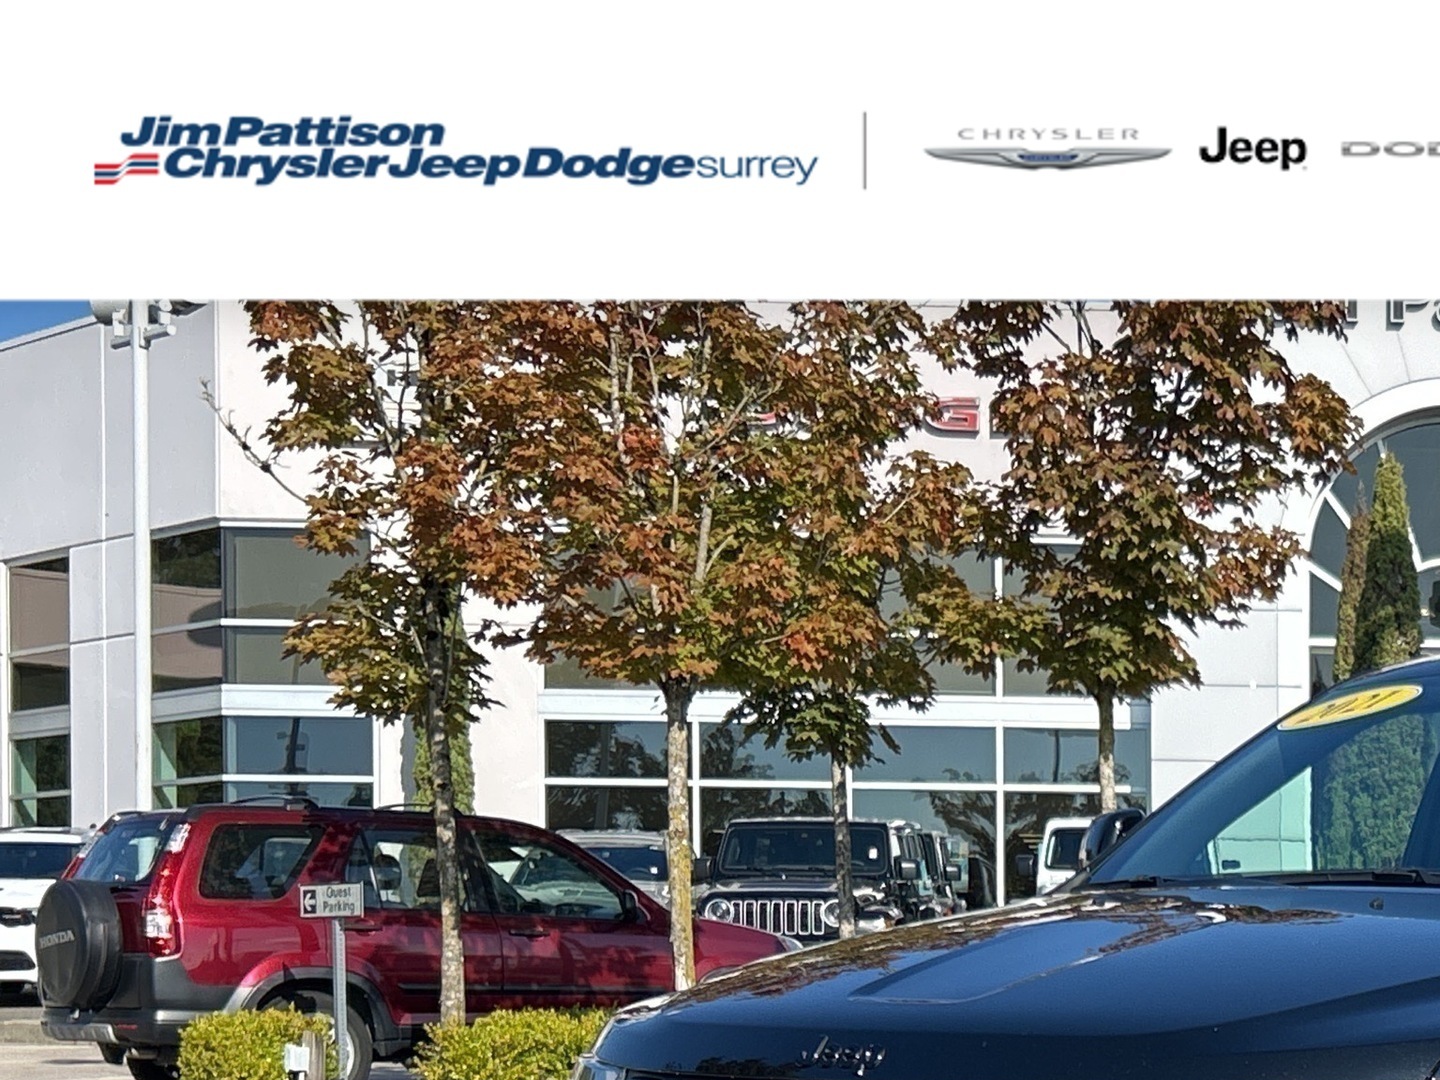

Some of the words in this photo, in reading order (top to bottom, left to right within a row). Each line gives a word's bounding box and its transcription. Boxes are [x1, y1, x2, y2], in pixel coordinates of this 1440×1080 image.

[326, 886, 352, 899] Guest
[322, 900, 356, 916] Parking
[39, 929, 75, 950] HONDA
